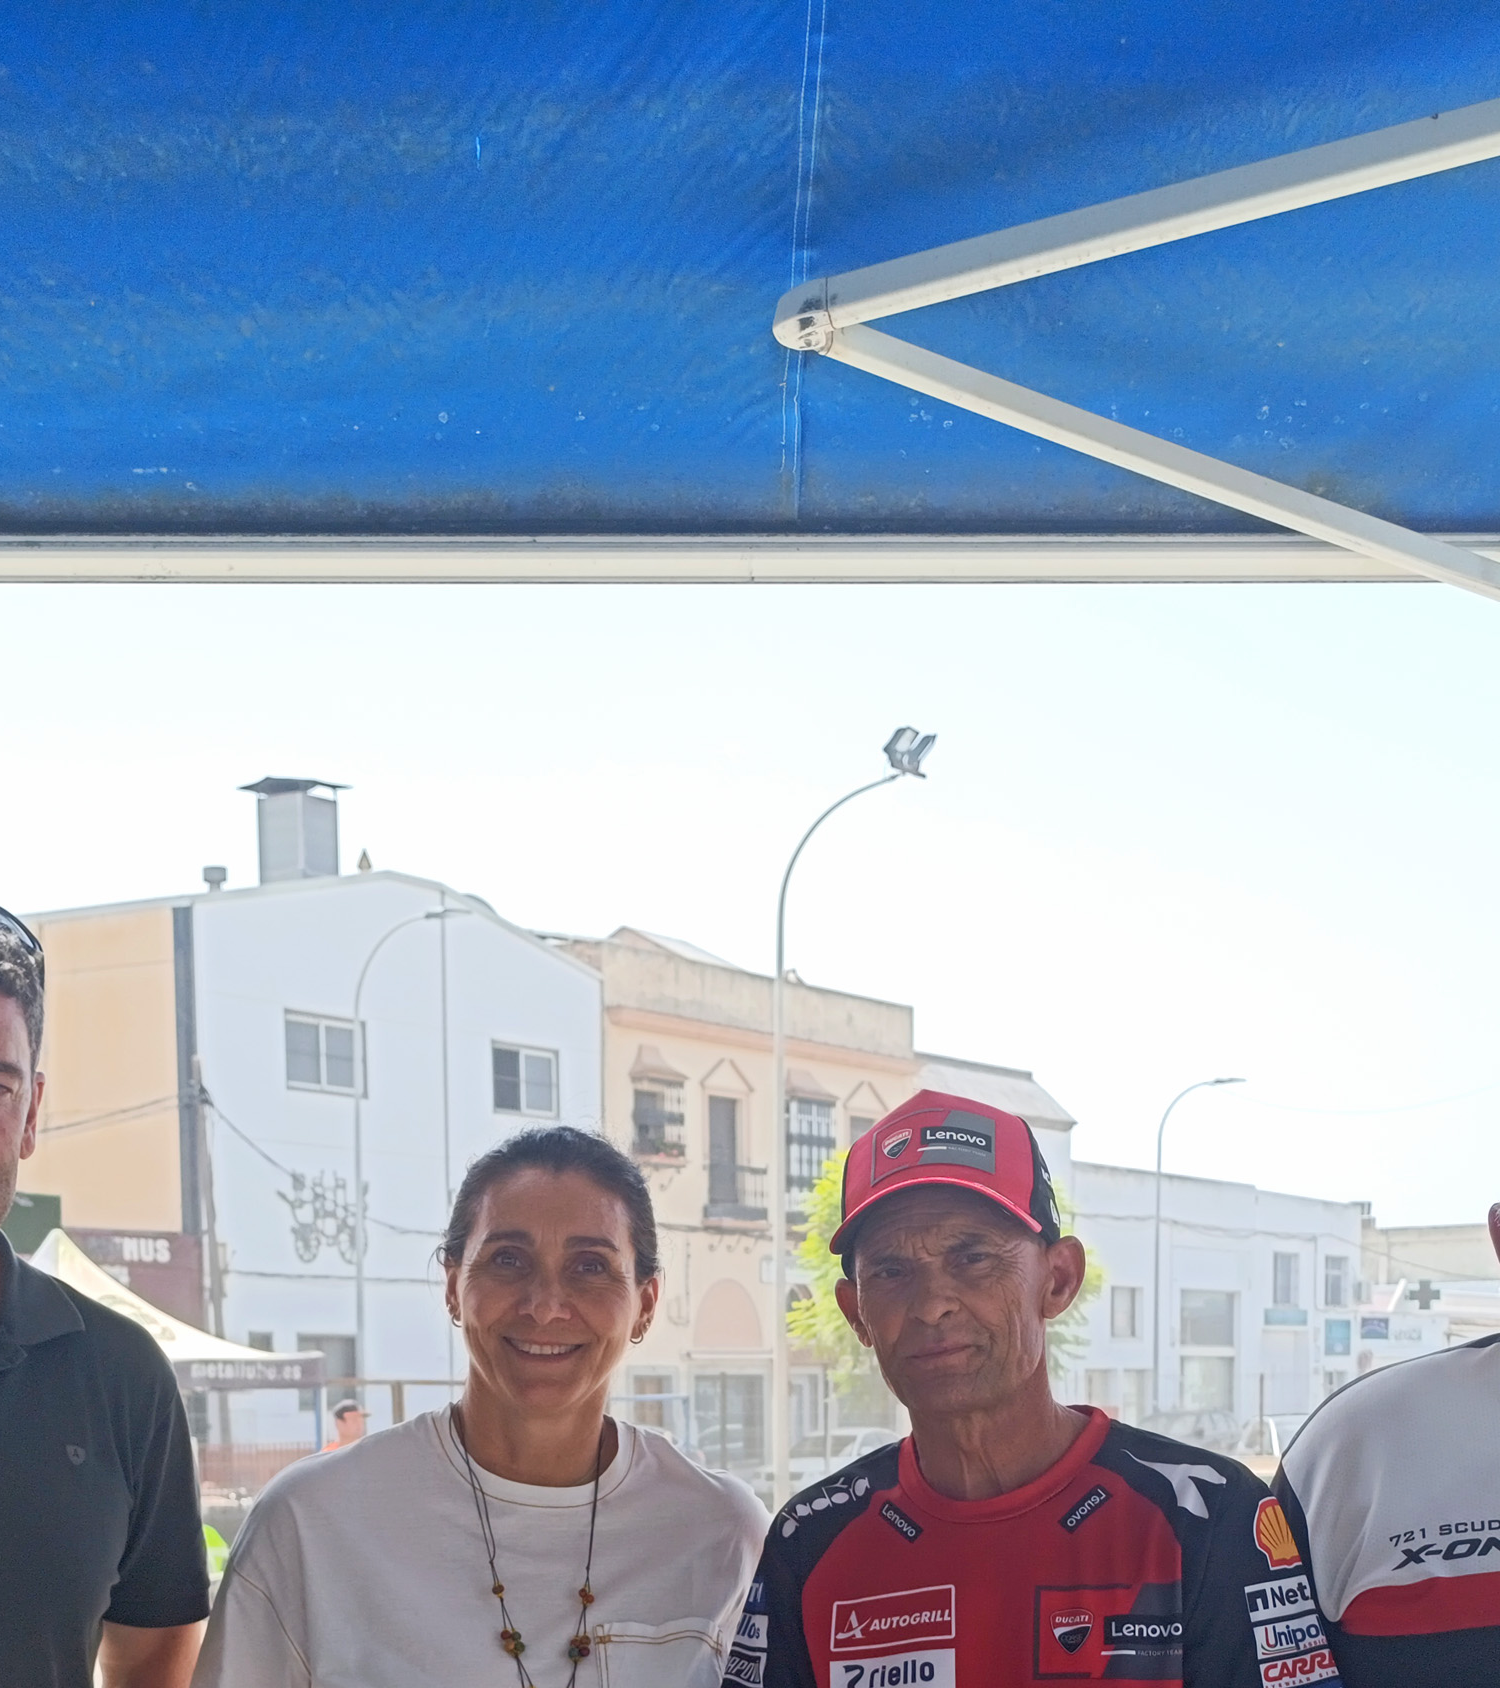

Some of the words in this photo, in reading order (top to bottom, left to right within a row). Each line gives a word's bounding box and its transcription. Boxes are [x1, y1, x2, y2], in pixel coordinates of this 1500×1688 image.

[926, 1129, 986, 1146] Lenovo
[1066, 1488, 1107, 1528] Lenovo
[882, 1503, 917, 1538] Lenovo
[1389, 1528, 1427, 1548] 721
[869, 1609, 951, 1631] AUTOGRILL
[1055, 1614, 1090, 1624] DUCATI
[1111, 1621, 1183, 1637] Lenovo
[869, 1659, 935, 1688] riello
